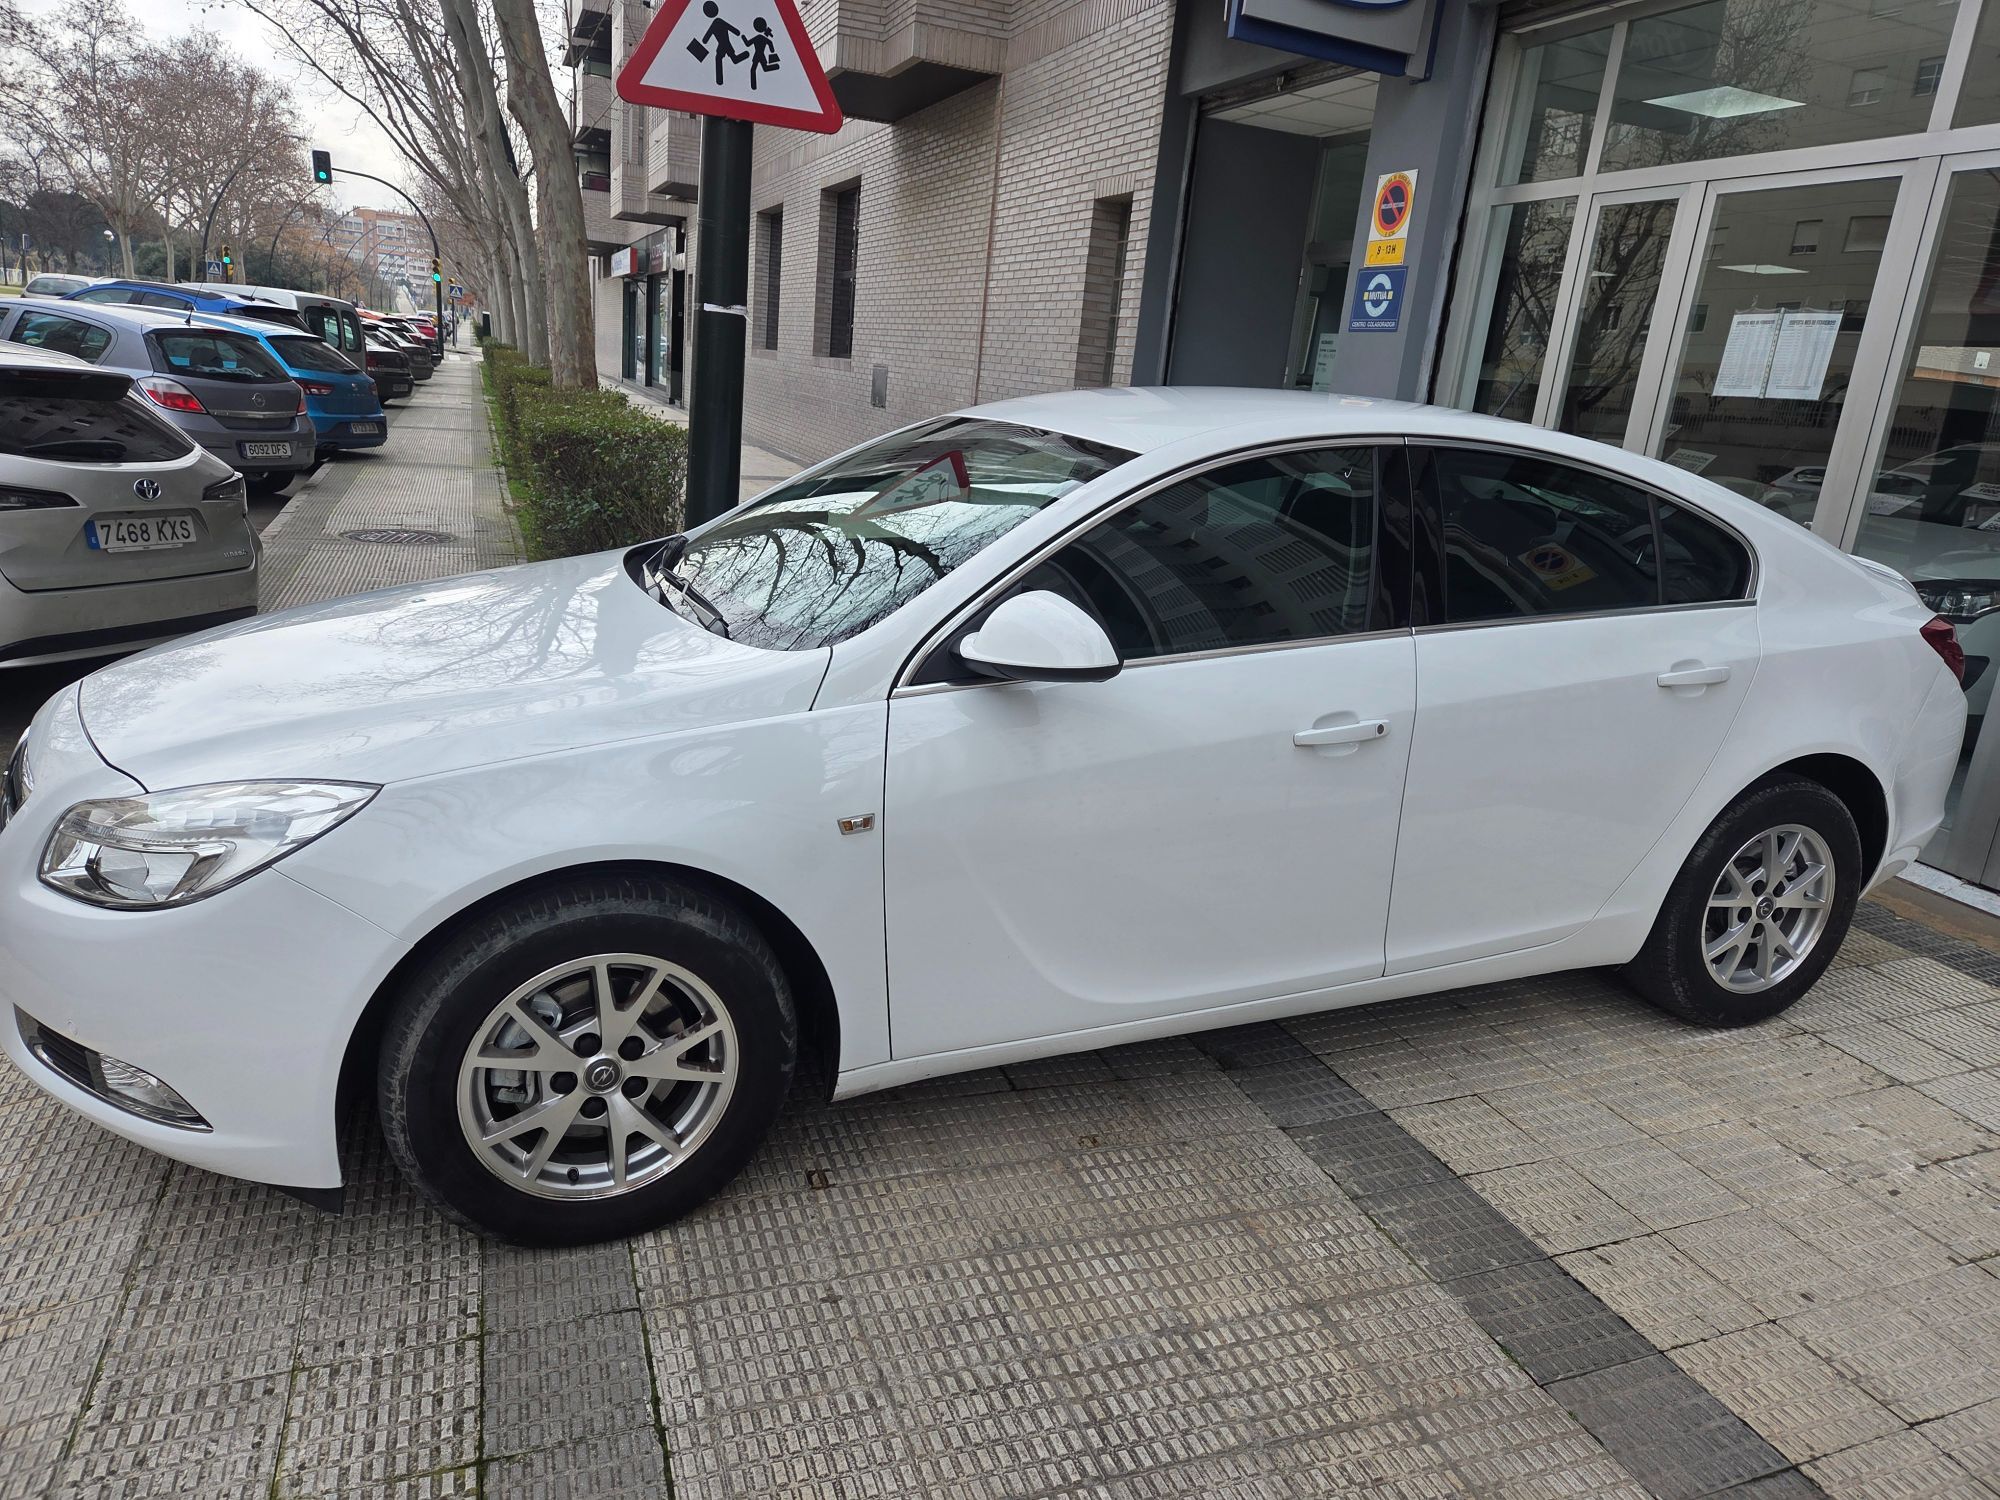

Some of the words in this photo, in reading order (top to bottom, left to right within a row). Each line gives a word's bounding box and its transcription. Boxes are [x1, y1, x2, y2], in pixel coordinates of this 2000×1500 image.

[1369, 291, 1387, 300] MUTUA
[248, 444, 270, 455] 6092
[271, 444, 288, 454] DFS
[100, 522, 151, 545] 7468
[156, 520, 191, 542] KXS
